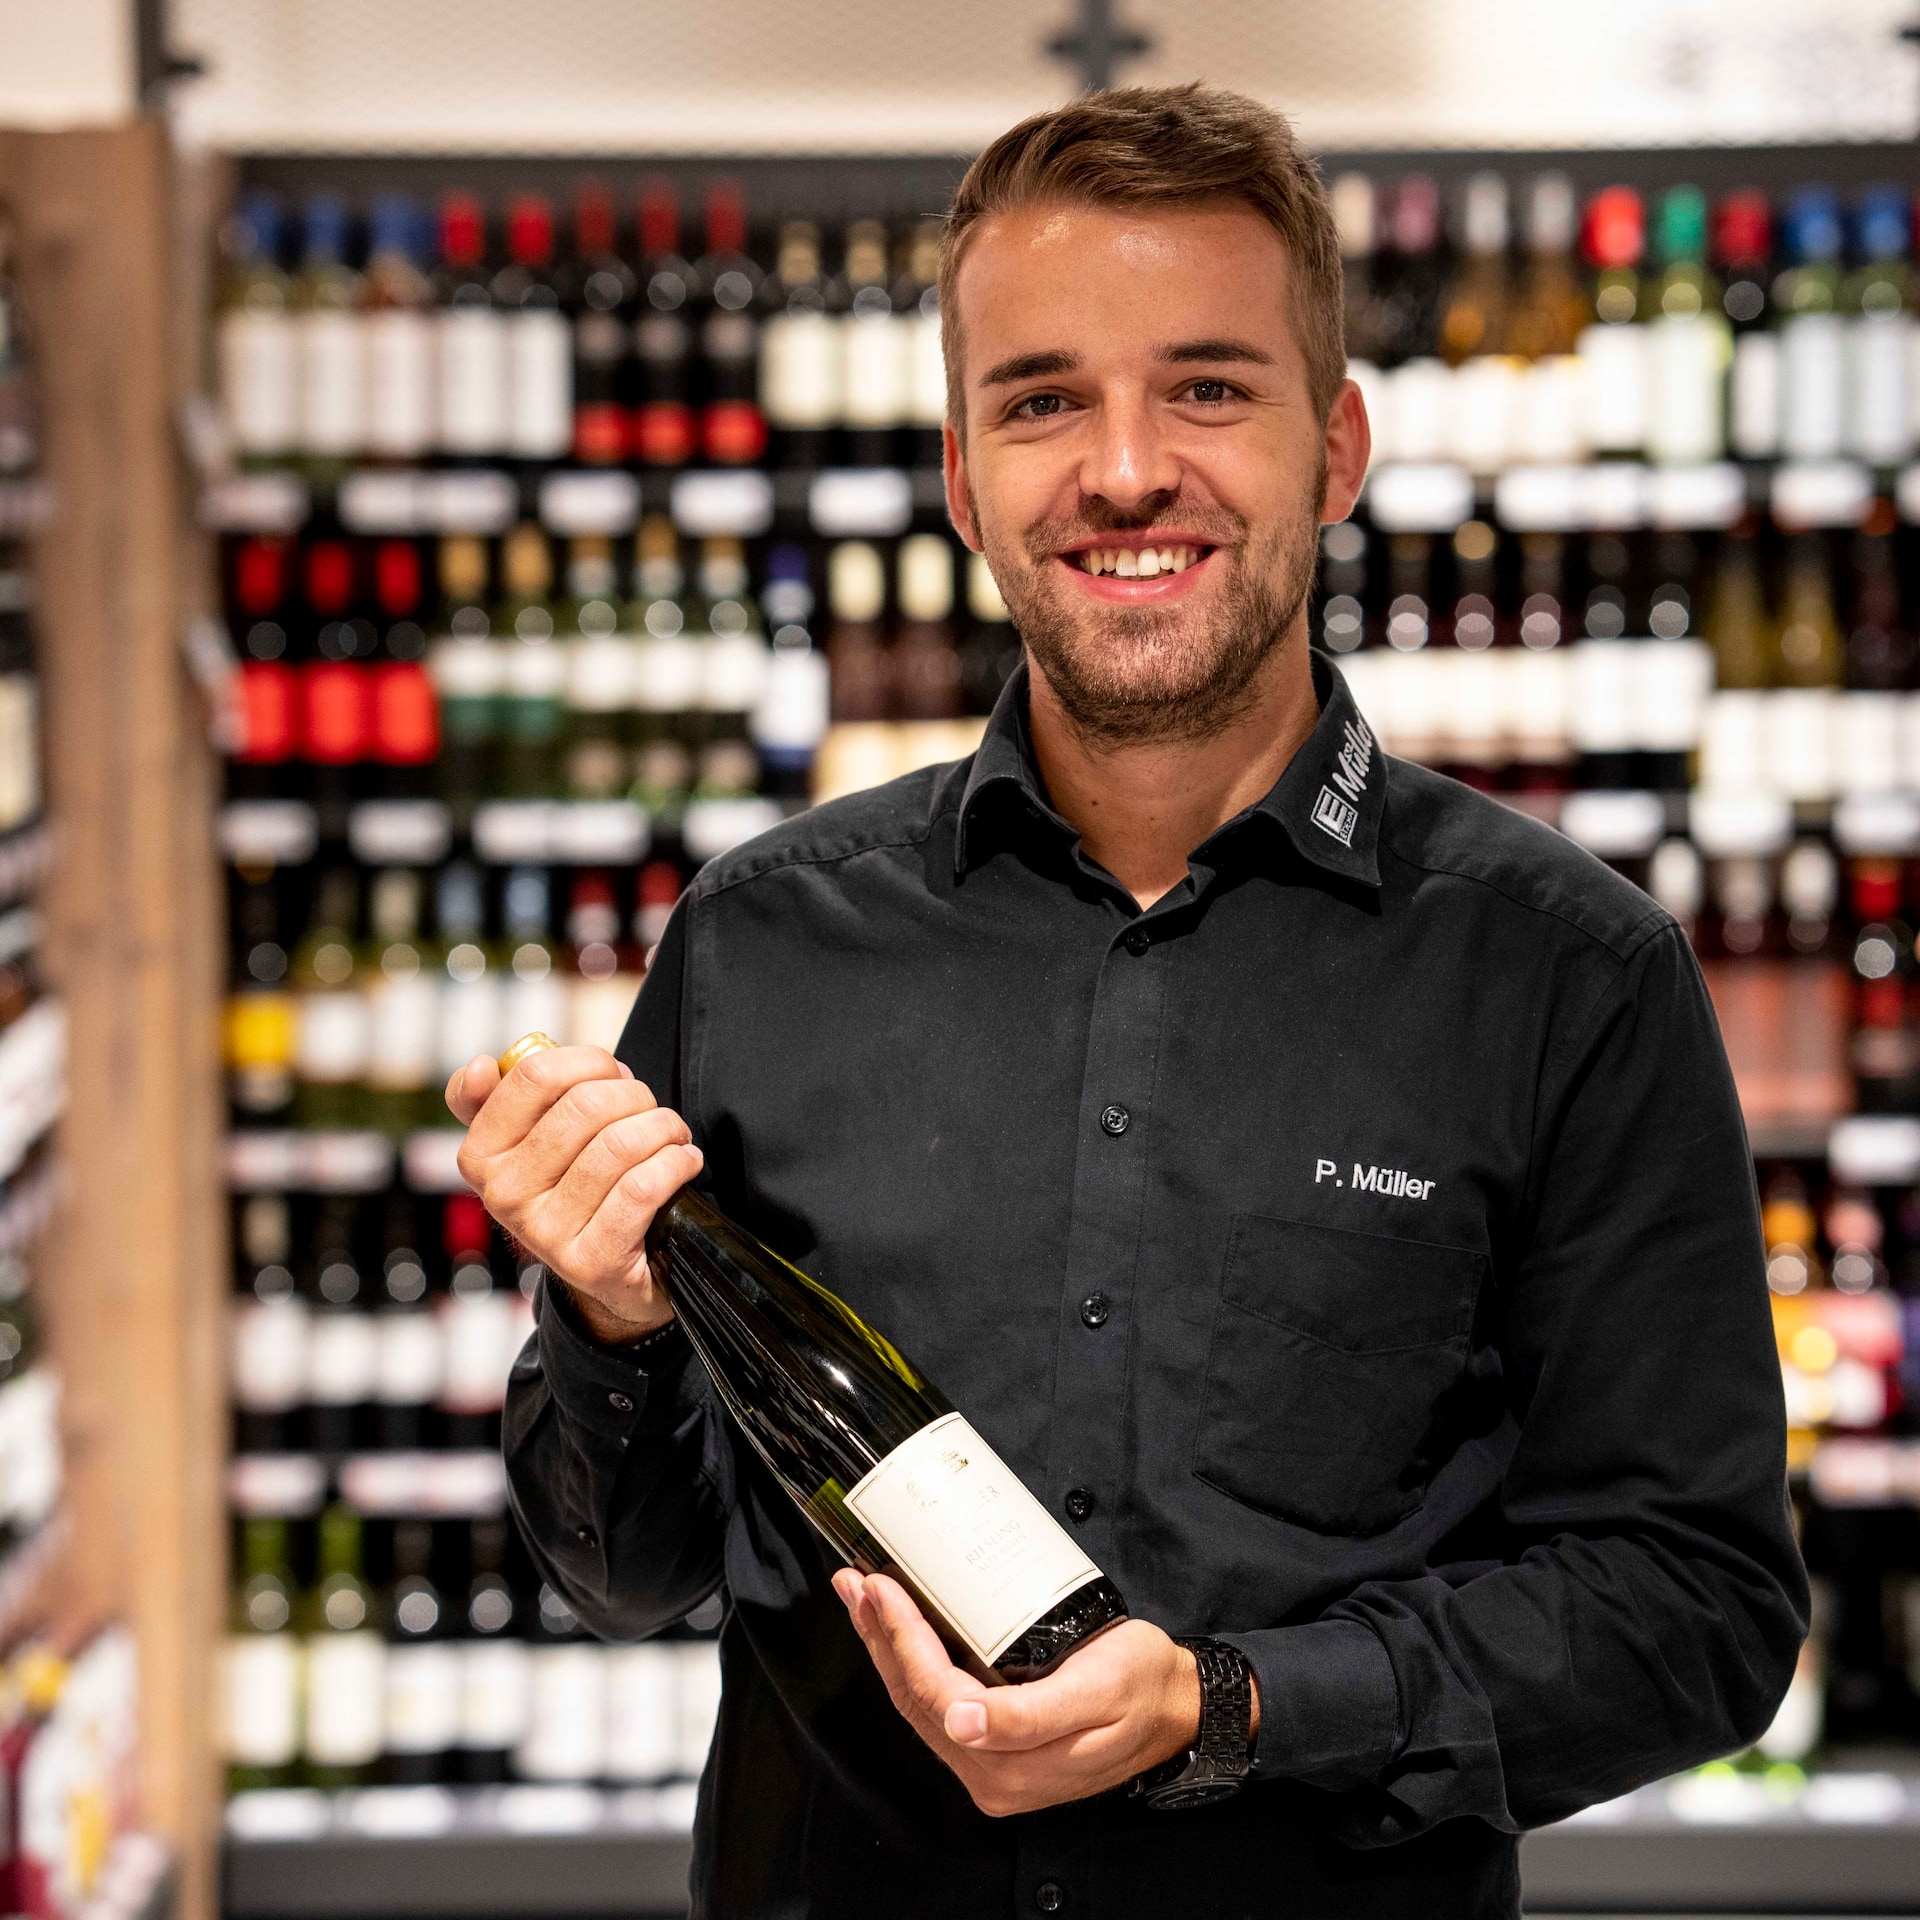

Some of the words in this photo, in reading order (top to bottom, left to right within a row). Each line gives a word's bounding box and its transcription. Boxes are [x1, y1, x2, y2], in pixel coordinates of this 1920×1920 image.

[1314, 1158, 1343, 1188] P.
[1351, 1163, 1436, 1201] Müller
[964, 1518, 1021, 1565] RIESLING
